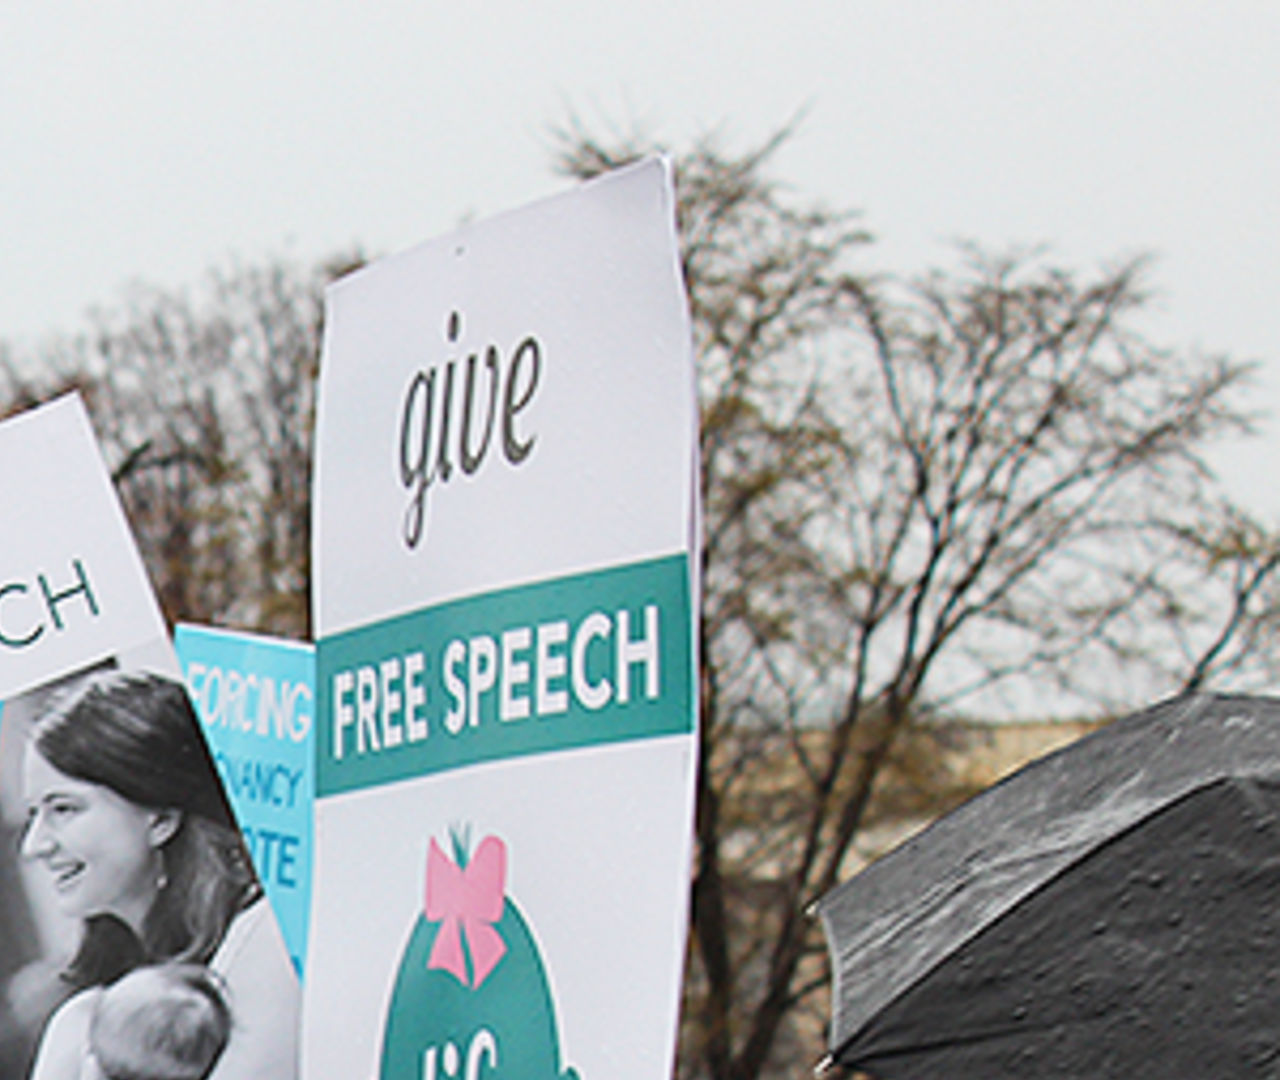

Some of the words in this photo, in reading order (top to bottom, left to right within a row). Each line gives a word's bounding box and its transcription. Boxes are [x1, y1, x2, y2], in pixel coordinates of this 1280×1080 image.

[400, 311, 540, 550] give
[333, 652, 428, 760] FREE
[443, 604, 660, 734] SPEECH
